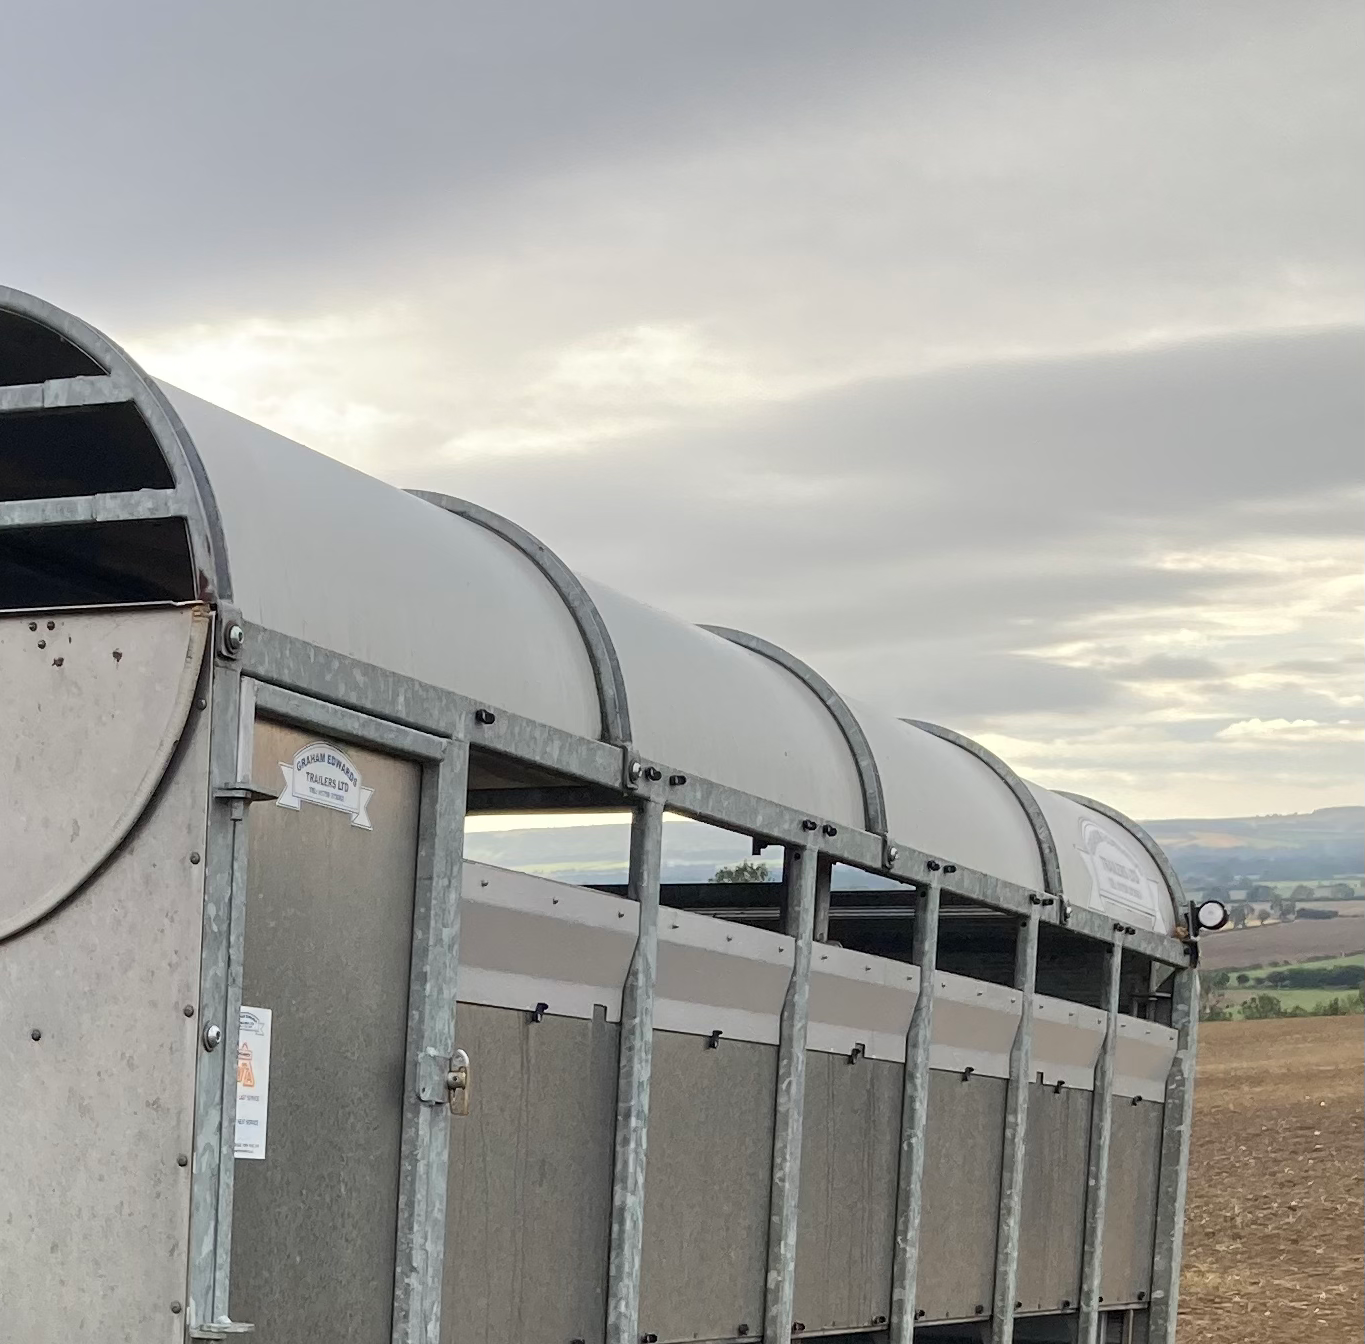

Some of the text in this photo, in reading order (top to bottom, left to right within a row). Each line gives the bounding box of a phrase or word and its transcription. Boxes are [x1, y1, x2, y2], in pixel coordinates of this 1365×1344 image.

[296, 753, 358, 787] GRAHAM EDWARDS
[305, 771, 349, 792] TRAILERS LTD
